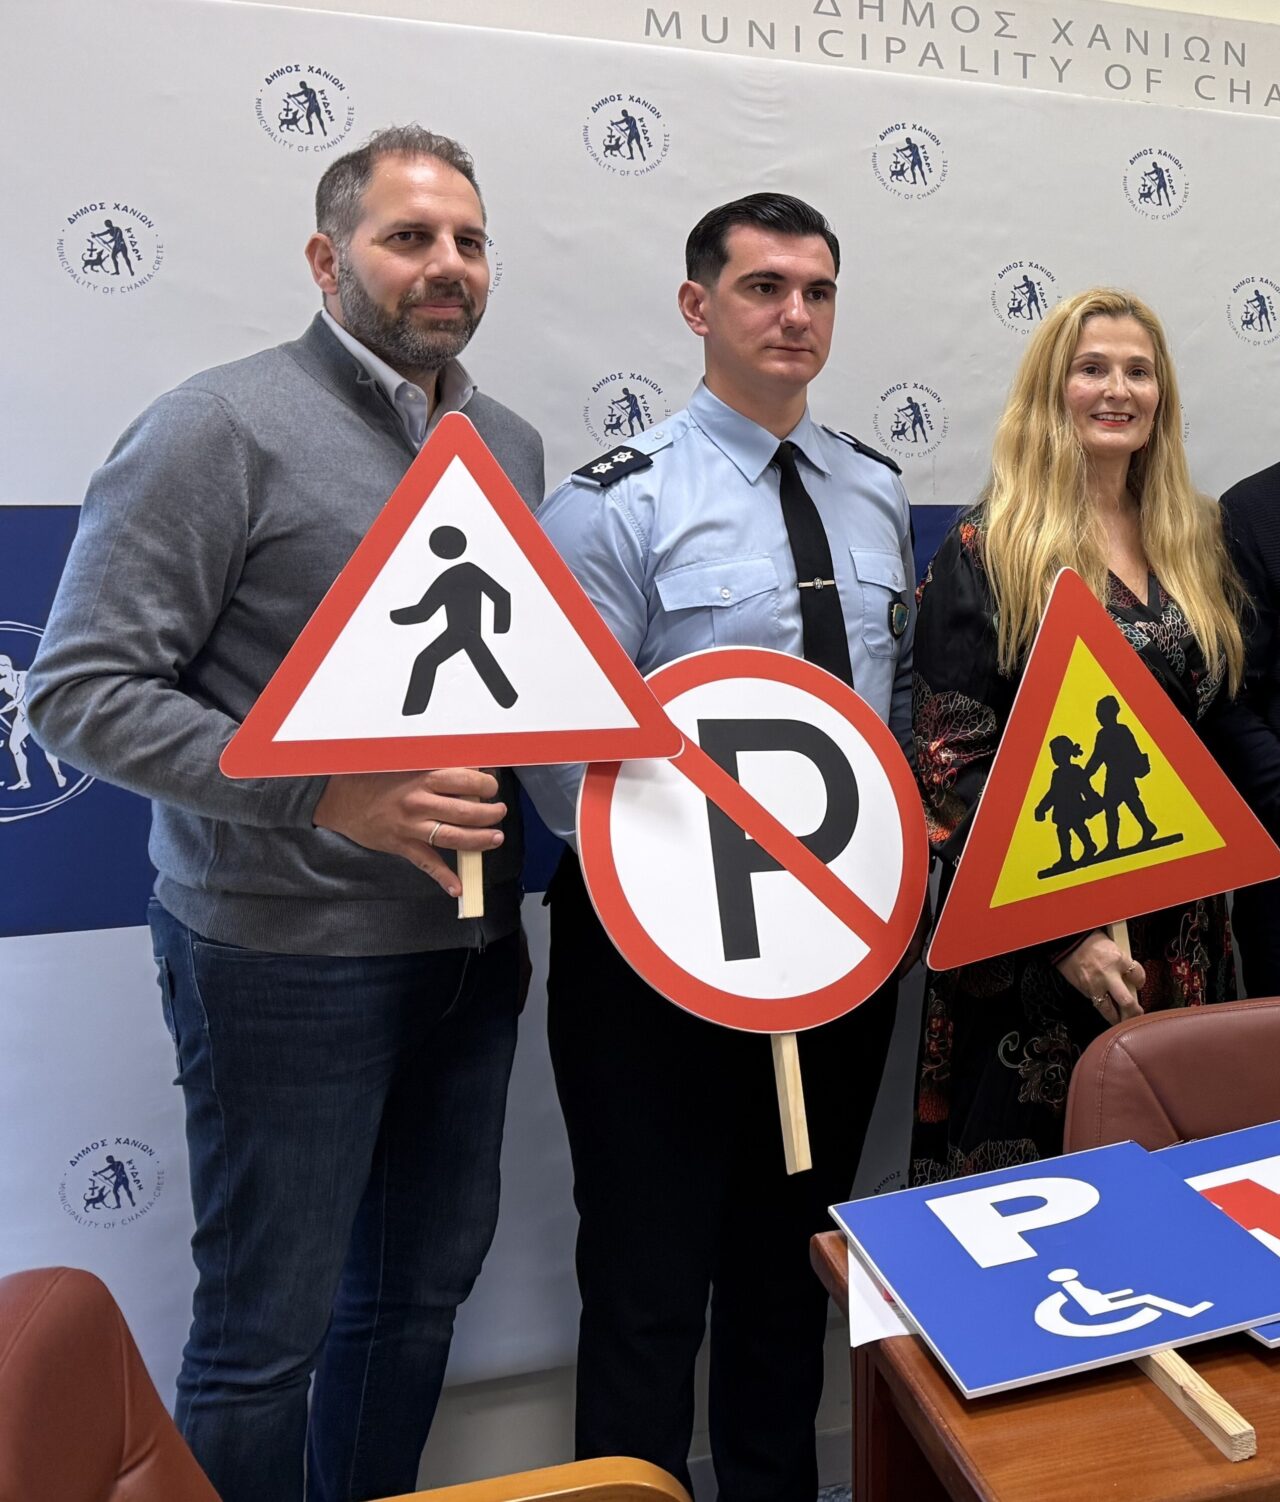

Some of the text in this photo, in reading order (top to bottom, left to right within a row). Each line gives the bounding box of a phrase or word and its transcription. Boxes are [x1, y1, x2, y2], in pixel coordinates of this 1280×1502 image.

[813, 0, 1246, 67] ΔΗΜΟΣ ΧΑΝΙΩΝ
[644, 8, 1072, 83] MUNICIPALITY
[1104, 64, 1162, 93] OF
[265, 64, 345, 91] ΔΗΜΟΣ ΧΑΝΙΩΝ
[592, 94, 661, 119] ΔΗΜΟΣ ΧΑΝΙΩΝ
[879, 123, 941, 146] ΔΗΜΟΣ ΧΑΝΙΩΝ
[1129, 148, 1183, 170] ΔΗΜΟΣ ΧΑΝΙΩΝ
[68, 202, 154, 228] ΔΗΜΟΣ ΧΑΝΙΩΝ
[998, 261, 1056, 282] ΔΗΜΟΣ ΧΑΝΙΩΝ
[592, 373, 663, 395] ΔΗΜΟΣ ΧΑΝΙΩΝ
[881, 383, 942, 403] ΔΗΜΟΣ ΧΑΝΙΩΝ
[583, 406, 614, 449] MUNICIPALIT
[697, 719, 859, 961] P
[69, 1138, 155, 1167] ΔΗΜΟΣ ΧΑΝΙΩΝ
[925, 1177, 1100, 1268] P
